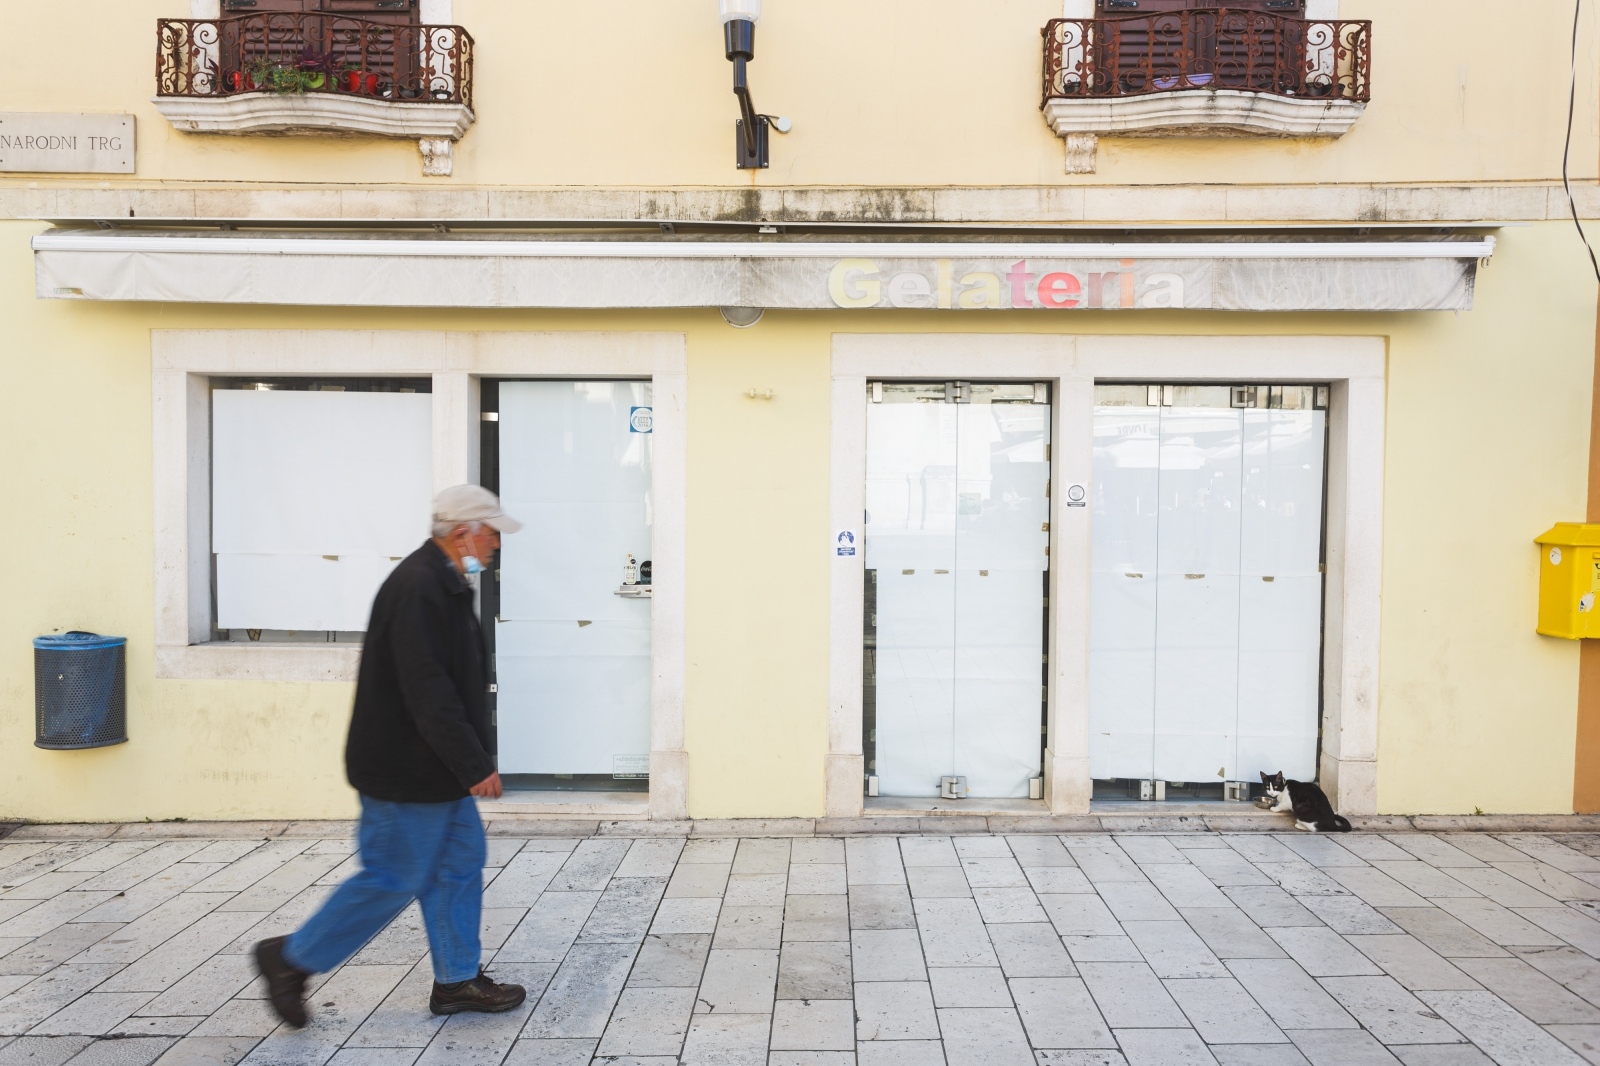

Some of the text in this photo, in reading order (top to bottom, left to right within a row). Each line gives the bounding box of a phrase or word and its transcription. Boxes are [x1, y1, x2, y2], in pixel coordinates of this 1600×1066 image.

[0, 135, 122, 150] NARODNI TRG
[828, 258, 1185, 309] Gelateria
